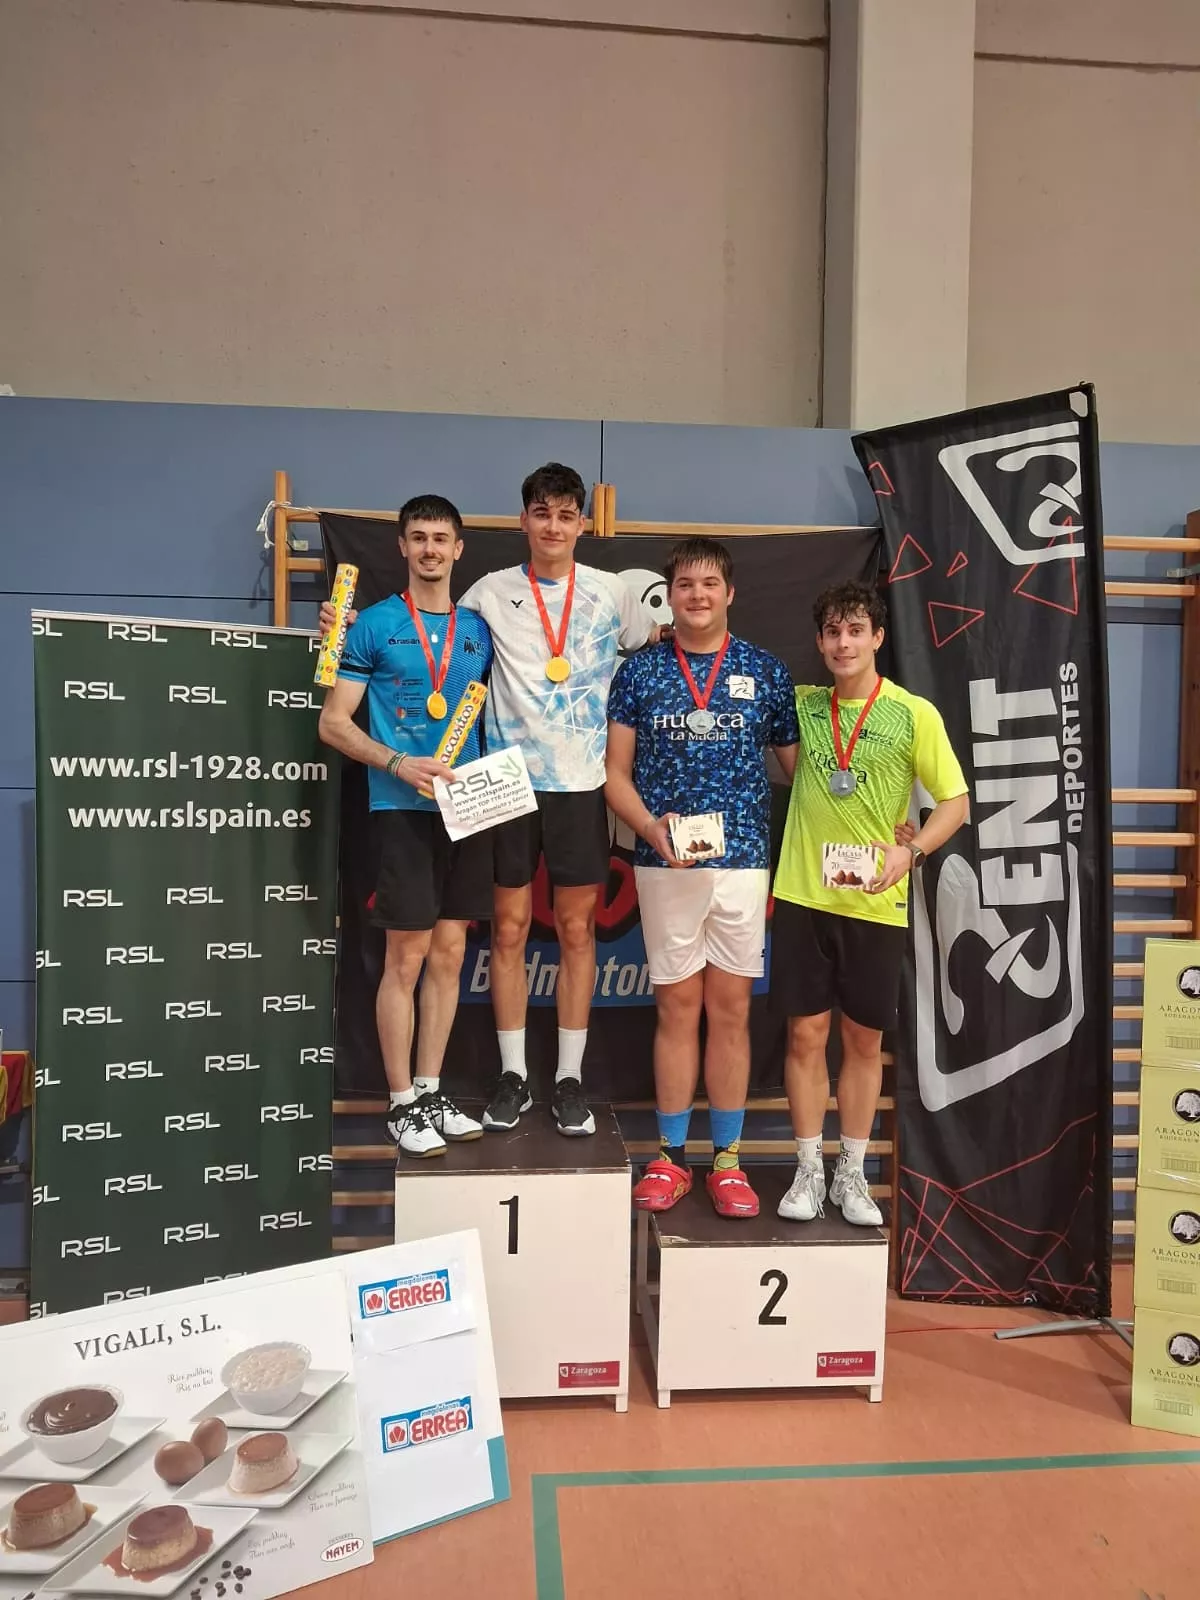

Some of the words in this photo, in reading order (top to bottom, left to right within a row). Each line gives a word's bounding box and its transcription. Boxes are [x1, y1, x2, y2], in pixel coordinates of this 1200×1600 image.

[32, 618, 62, 637] SL
[108, 623, 168, 643] RSL
[211, 630, 267, 649] RSL
[64, 680, 125, 701] RSL
[168, 685, 227, 705] RSL
[653, 713, 745, 729] Huca
[441, 704, 474, 765] acasitos
[1059, 661, 1085, 834] DEPORTES
[50, 752, 328, 781] www.rsl-1928.com
[445, 770, 504, 800] RSL
[68, 801, 311, 834] www.rslspain.es
[64, 889, 123, 908] RSL
[166, 887, 223, 905] RSL
[264, 885, 318, 902] RSL
[106, 946, 164, 965] RSL
[206, 942, 262, 960] RSL
[303, 939, 336, 956] RS
[36, 950, 61, 969] SL
[470, 949, 654, 997] Bdmton
[165, 1000, 221, 1020] RSL
[262, 995, 315, 1013] RSL
[62, 1006, 123, 1026] RSL
[205, 1053, 260, 1073] RSL
[300, 1046, 334, 1065] RS
[35, 1068, 60, 1088] SL
[105, 1061, 163, 1081] RSL
[164, 1112, 220, 1133] RSL
[260, 1104, 313, 1124] RSL
[62, 1122, 122, 1142] RSL
[204, 1164, 259, 1184] RSL
[299, 1154, 333, 1174] RS
[104, 1174, 162, 1196] RSL
[33, 1185, 60, 1206] SL
[259, 1211, 312, 1232] RSL
[499, 1195, 519, 1255] 1
[163, 1223, 220, 1244] RSL
[61, 1236, 121, 1258] RSL
[388, 1280, 446, 1311] ERREA
[758, 1269, 789, 1326] 2
[73, 1323, 173, 1361] VIGALI,
[180, 1313, 222, 1337] S.L.
[570, 1366, 607, 1376] Zaragoza
[829, 1356, 864, 1366] Zaragoza
[411, 1407, 468, 1444] ERREA
[326, 1540, 360, 1560] NAYEM
